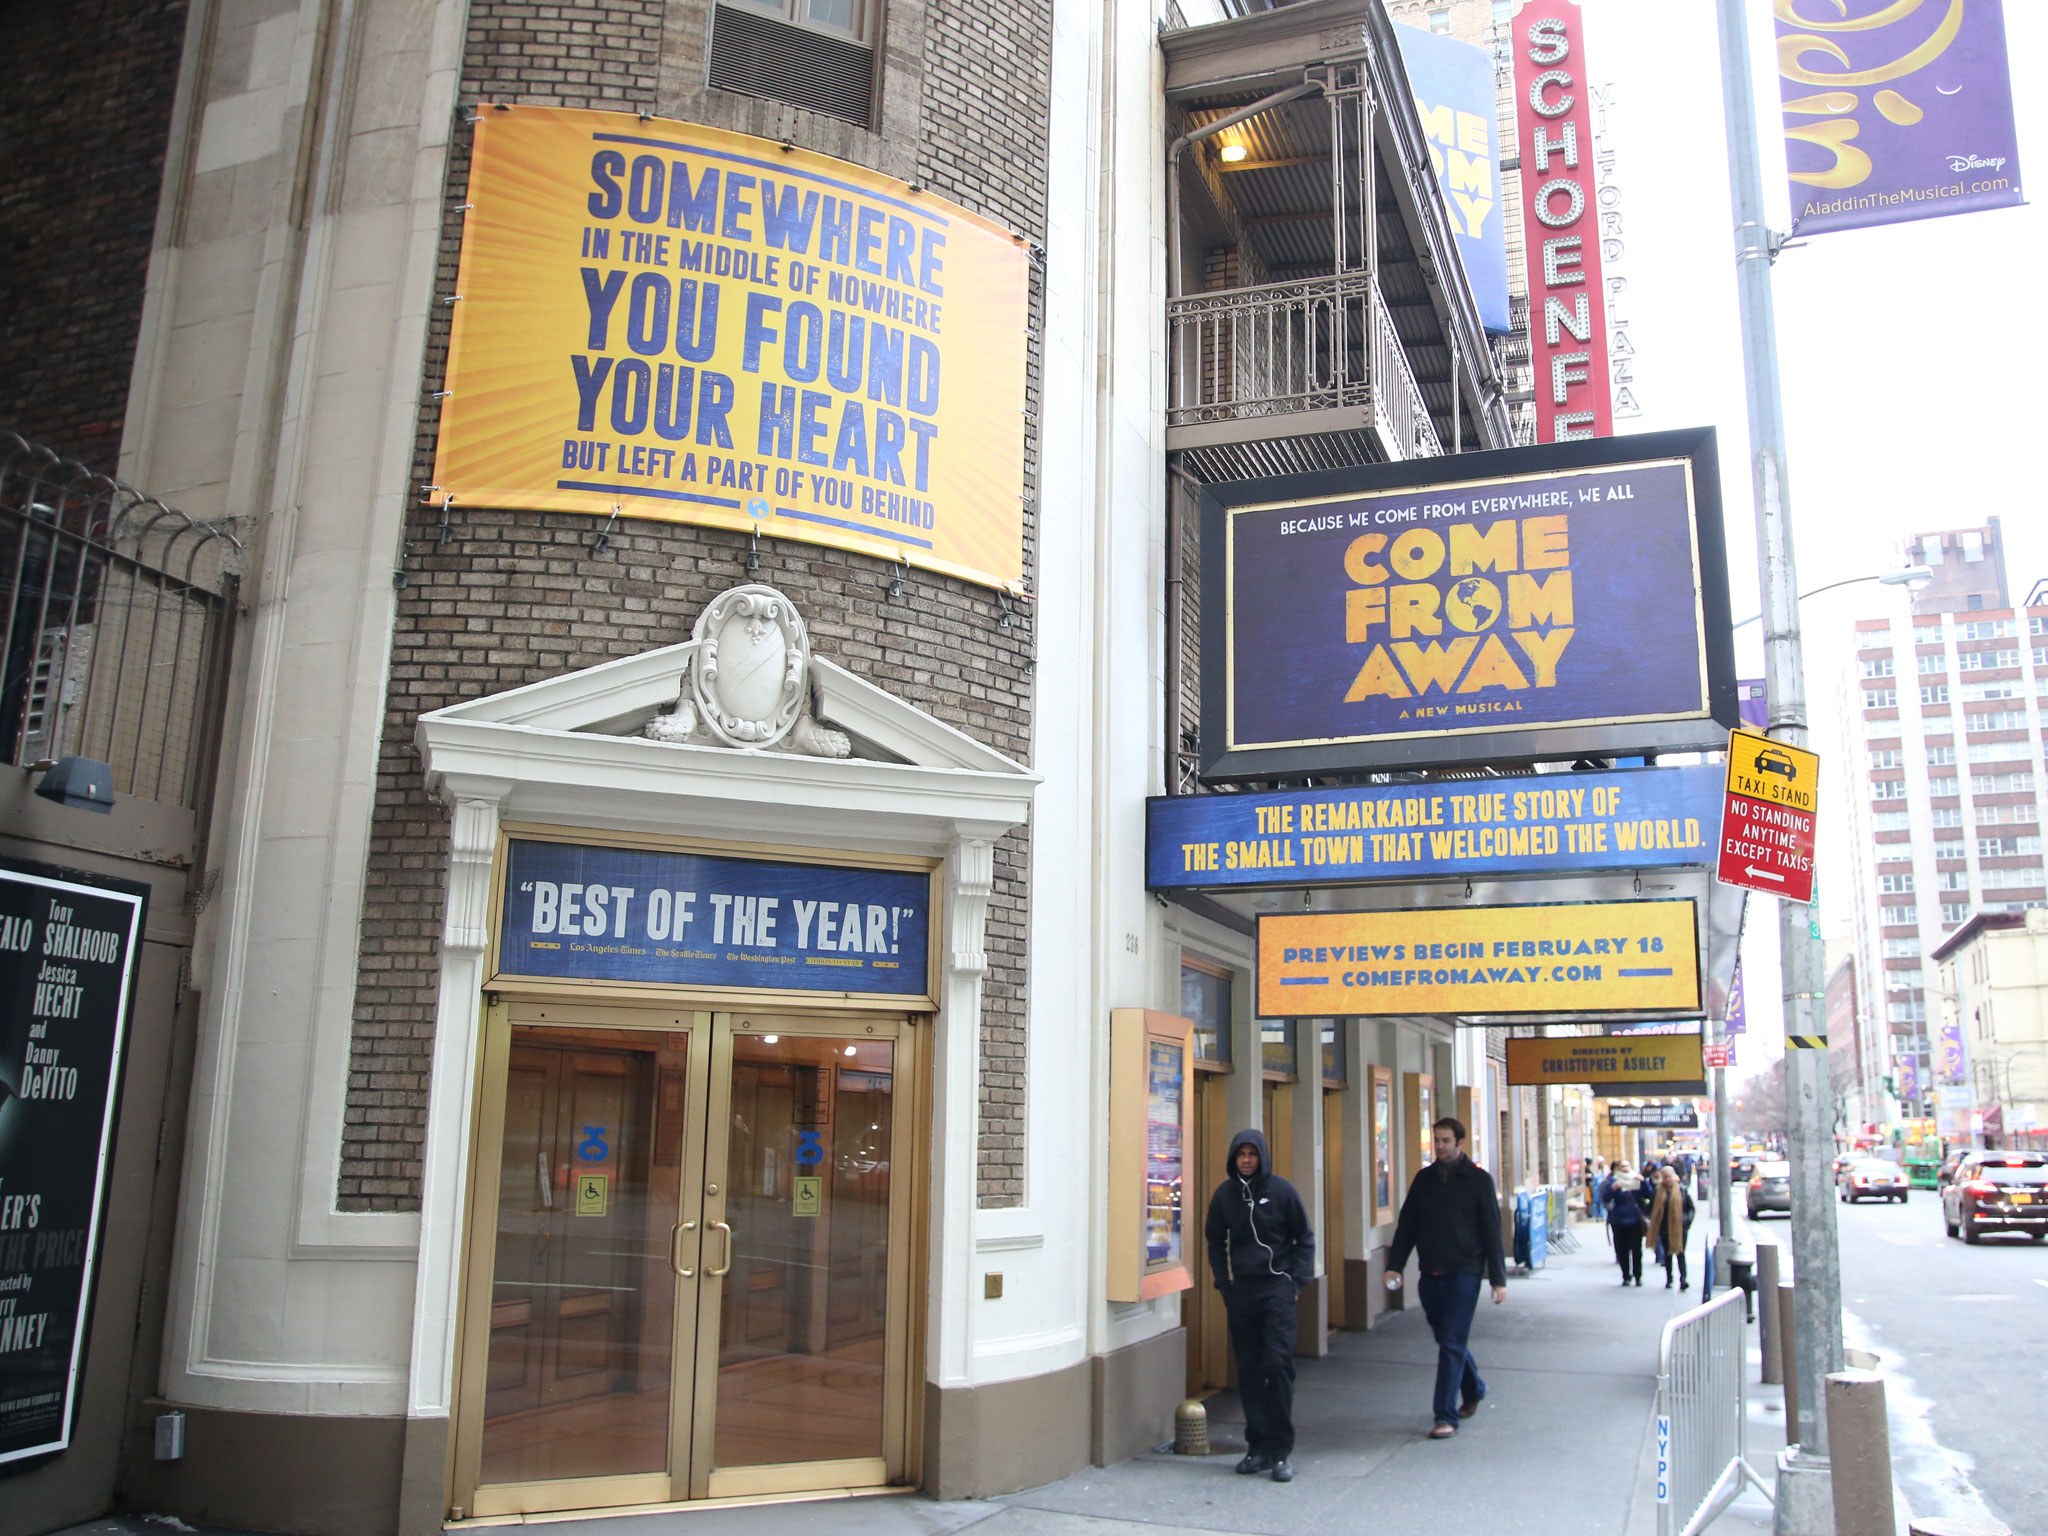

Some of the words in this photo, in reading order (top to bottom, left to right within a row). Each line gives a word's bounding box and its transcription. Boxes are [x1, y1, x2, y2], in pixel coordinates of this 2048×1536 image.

[1803, 176, 2009, 216] AladdinTheMusical.com
[587, 149, 946, 298] SOMEWHERE
[1588, 82, 1626, 263] MILFORD
[1607, 277, 1640, 412] PLAZA
[581, 226, 610, 258] IN
[620, 229, 670, 267] THE
[679, 241, 778, 288] MIDDLE
[788, 260, 821, 296] OF
[828, 272, 941, 335] NOWHERE
[579, 267, 719, 363] YOU
[742, 293, 941, 417] FOUND
[571, 354, 735, 450] YOUR
[758, 382, 938, 493] HEART
[562, 439, 609, 472] BUT
[617, 443, 674, 479] LEFT
[681, 456, 698, 483] A
[707, 458, 768, 495] PART
[775, 467, 805, 499] OF
[810, 474, 853, 510] YOU
[860, 487, 935, 531] BEHIND
[1280, 513, 1344, 536] BECAUSE
[1348, 511, 1370, 529] WE
[1375, 506, 1418, 525] COME
[1423, 501, 1466, 520] FROM
[1471, 490, 1574, 516] EVERYWHERE,
[1578, 487, 1601, 503] WE
[1606, 483, 1635, 501] ALL
[1343, 514, 1569, 585] COME
[1342, 627, 1577, 703] AWAY
[1399, 709, 1410, 720] A
[1415, 706, 1449, 718] NEW
[1455, 700, 1523, 715] MUSICAL
[1737, 776, 1765, 795] TAXI
[1772, 785, 1810, 807] STAND
[1255, 805, 1294, 835] THE
[1300, 796, 1444, 834] REMARKABLE
[1449, 793, 1507, 825] TRUE
[1512, 789, 1585, 821] STORY
[1592, 786, 1621, 816] OF
[1731, 799, 1747, 817] NO
[1752, 804, 1811, 833] STANDING
[1182, 842, 1219, 872] THE
[1225, 837, 1296, 870] SMALL
[1301, 834, 1363, 866] TOWN
[1369, 831, 1422, 863] THAT
[1427, 824, 1557, 861] WELCOMED
[1563, 822, 1608, 853] THE
[1614, 818, 1707, 851] WORLD.
[1726, 838, 1772, 863] EXCEPT
[1742, 823, 1796, 850] ANYTIME
[49, 898, 74, 926] Tony
[646, 888, 696, 942] OF
[709, 893, 779, 948] THE
[0, 914, 33, 952] ALO
[43, 922, 120, 964] SHALHOUB
[570, 942, 585, 951] Los
[586, 944, 618, 954] Angeles
[620, 945, 646, 956] Times
[655, 948, 670, 957] The
[671, 948, 694, 958] Seattle
[695, 950, 717, 960] Times
[1126, 932, 1139, 955] 236
[1283, 945, 1406, 964] PREVIEWS
[1413, 941, 1485, 960] BEGIN
[1492, 938, 1626, 958] FEBRUARY
[1638, 936, 1664, 954] 18
[38, 959, 77, 985] Jessica
[727, 953, 738, 961] The
[740, 953, 779, 964] Washington
[781, 955, 796, 965] Post
[1341, 964, 1602, 987] COMEFROMAWAY.COM
[33, 982, 83, 1019] HECHT
[29, 1020, 47, 1039] and
[25, 1041, 60, 1067] Danny
[1542, 1058, 1617, 1072] CHRISTOPHER
[1623, 1056, 1666, 1071] ASHLEY
[1572, 1047, 1617, 1055] DIRECTED
[20, 1065, 78, 1100] DeVITO
[0, 1194, 41, 1231] ER'S
[23, 1273, 33, 1292] by
[0, 1313, 48, 1354] NNEY
[1657, 1419, 1668, 1499] NYPD
